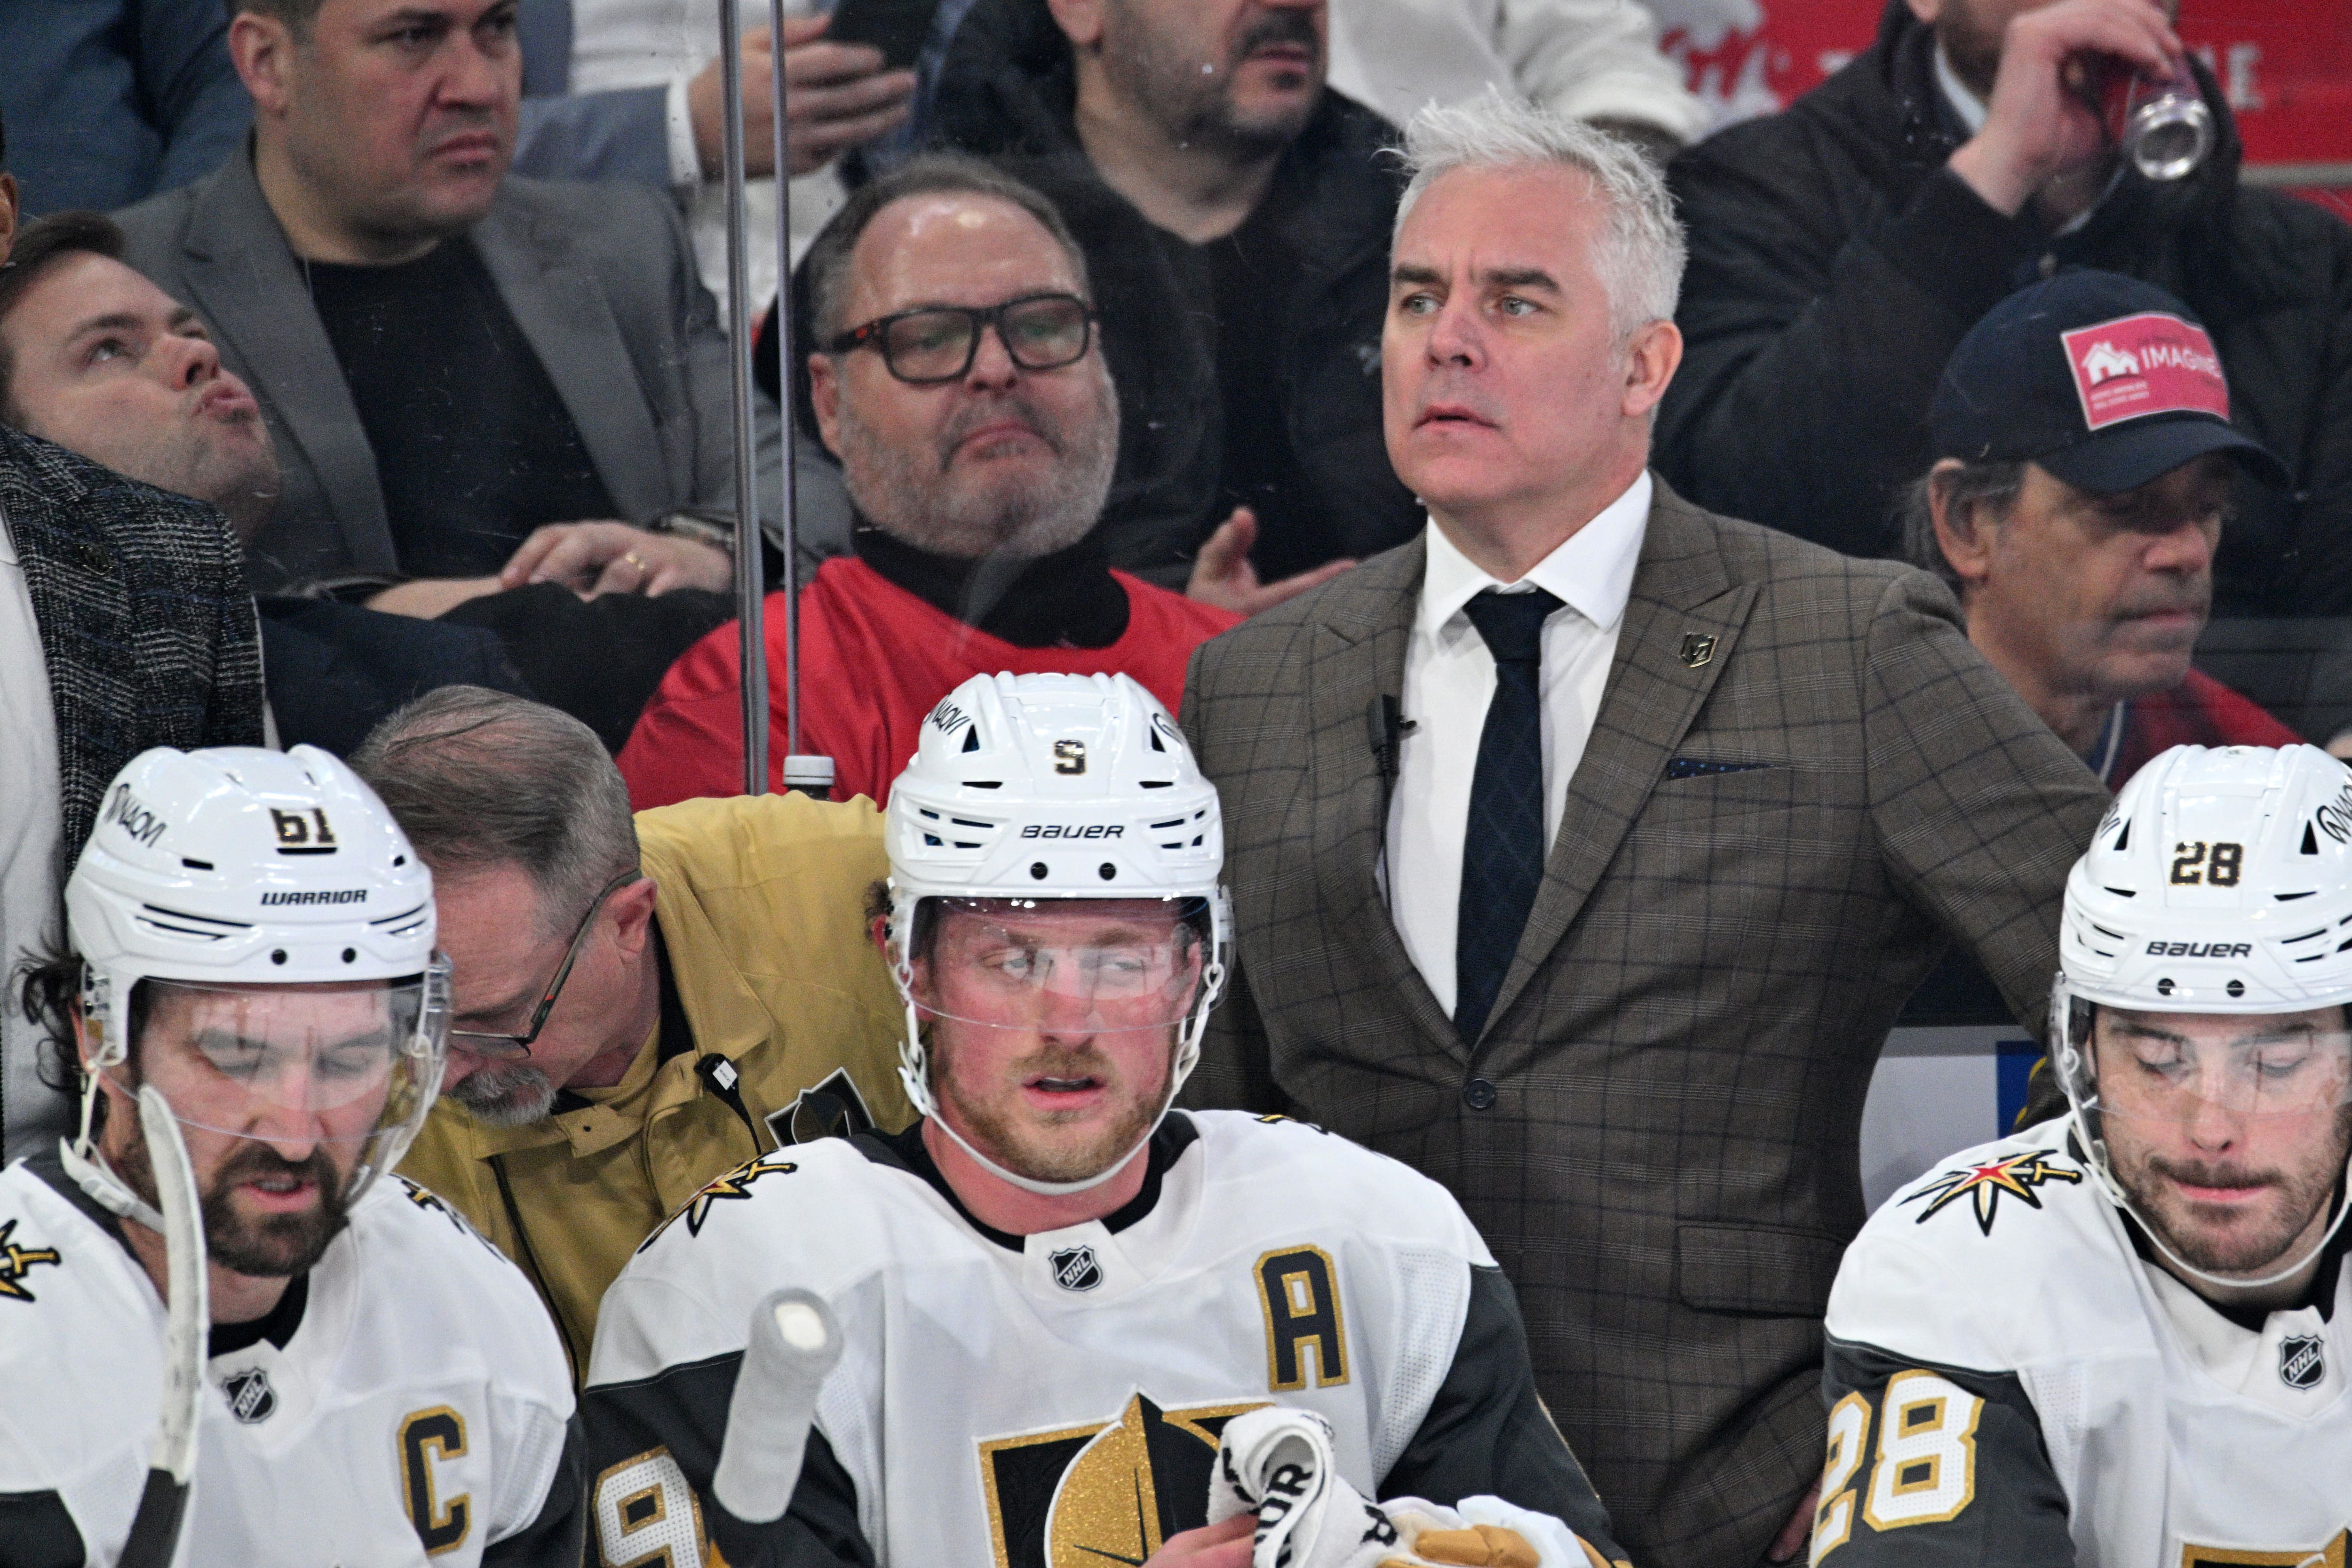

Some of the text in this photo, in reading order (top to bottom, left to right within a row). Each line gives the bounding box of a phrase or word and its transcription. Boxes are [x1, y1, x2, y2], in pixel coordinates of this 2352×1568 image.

[1054, 740, 1087, 775] 9
[2169, 841, 2243, 888] 28
[261, 890, 368, 906] WARRIOR
[1063, 1256, 1091, 1285] NHL
[1252, 1242, 1349, 1392] A
[2288, 1346, 2317, 1379] NHL
[238, 1381, 262, 1416] NHL
[397, 1405, 472, 1559] C
[1809, 1369, 1986, 1568] 28
[592, 1444, 708, 1568] 9
